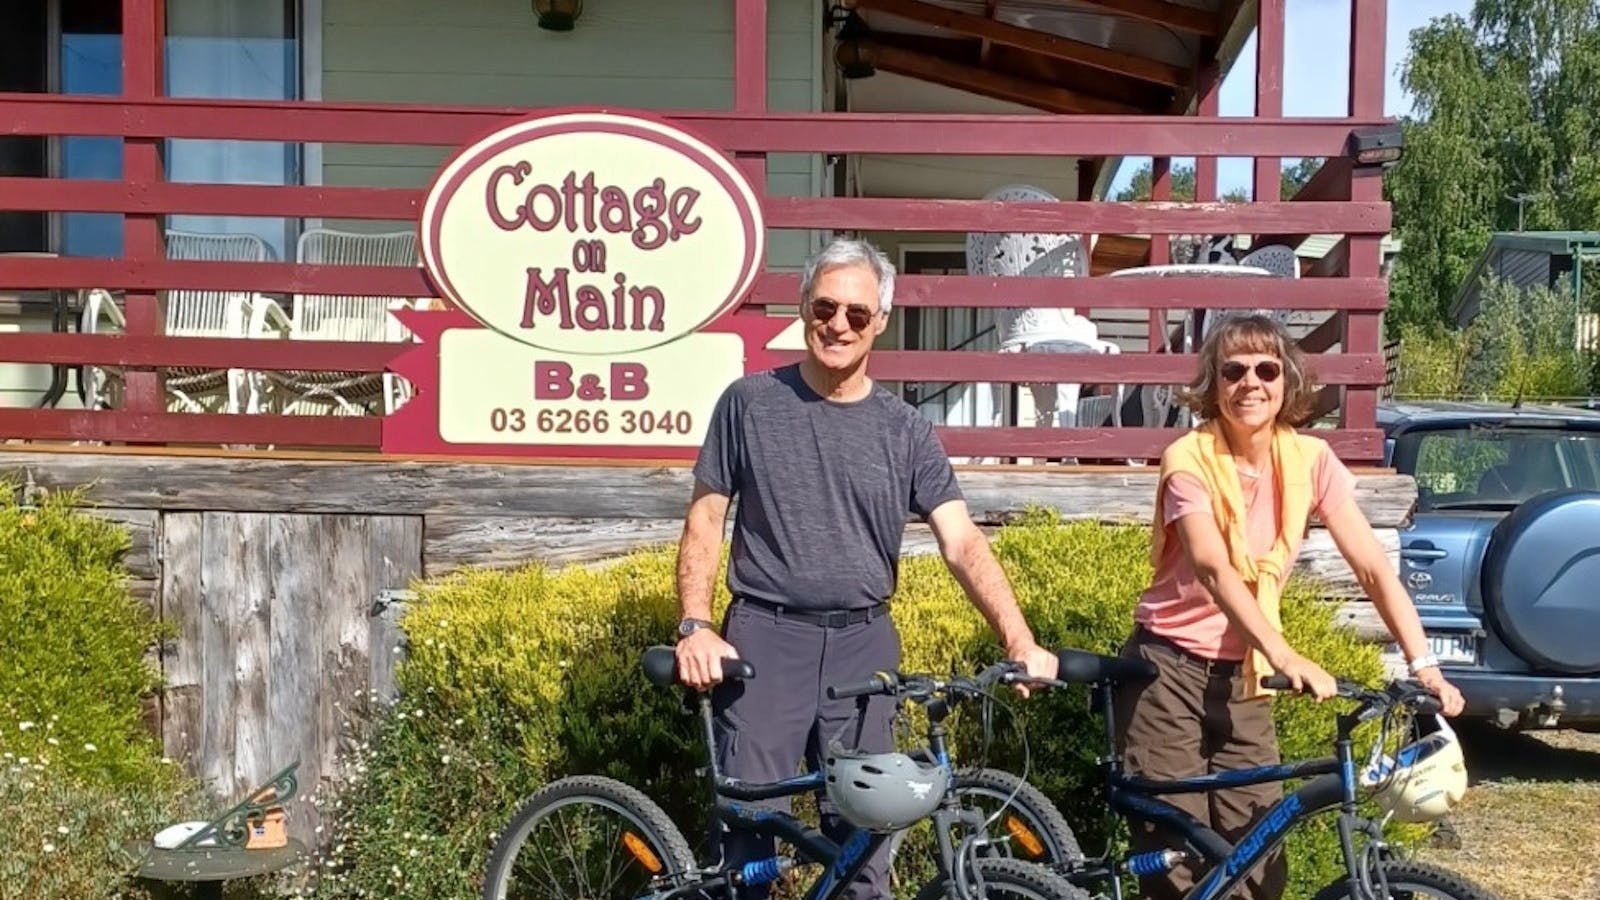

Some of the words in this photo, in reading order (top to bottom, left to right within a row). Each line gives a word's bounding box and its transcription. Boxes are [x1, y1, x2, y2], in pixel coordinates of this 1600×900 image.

[486, 161, 702, 250] Cottage
[573, 239, 607, 273] on
[520, 267, 665, 332] Main
[535, 361, 650, 401] B&B
[490, 408, 526, 432] 03
[536, 409, 610, 433] 6266
[620, 410, 692, 434] 3040
[1228, 793, 1301, 875] HYPER
